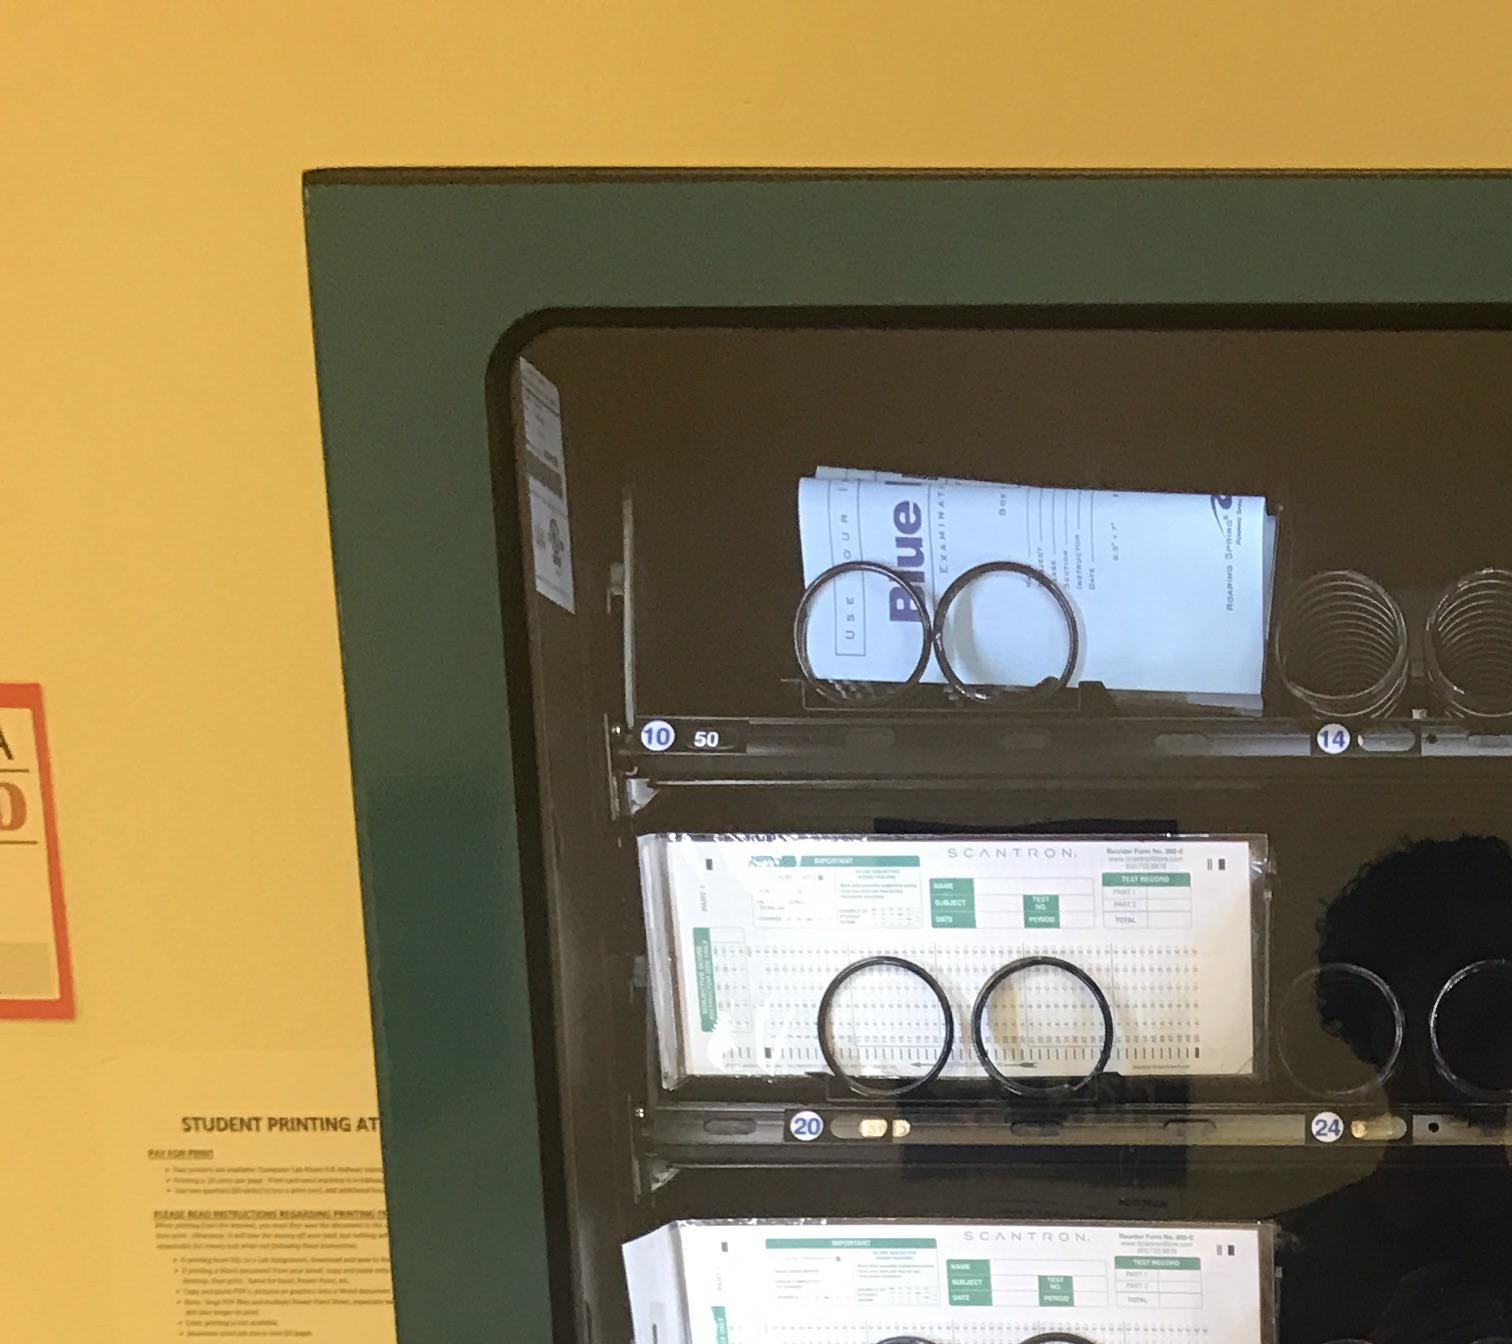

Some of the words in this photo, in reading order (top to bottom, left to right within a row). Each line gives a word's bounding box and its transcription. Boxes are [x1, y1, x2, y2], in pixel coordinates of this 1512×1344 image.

[644, 728, 670, 745] 10
[694, 732, 719, 747] 50
[1320, 730, 1345, 748] 14
[948, 848, 1074, 858] SCANTRON
[182, 1117, 262, 1132] STUDENT
[268, 1117, 351, 1132] PRINTING
[356, 1117, 380, 1132] AT
[794, 1118, 821, 1135] 20
[1316, 1119, 1340, 1136] 24
[964, 1231, 1086, 1241] SCANTRON
